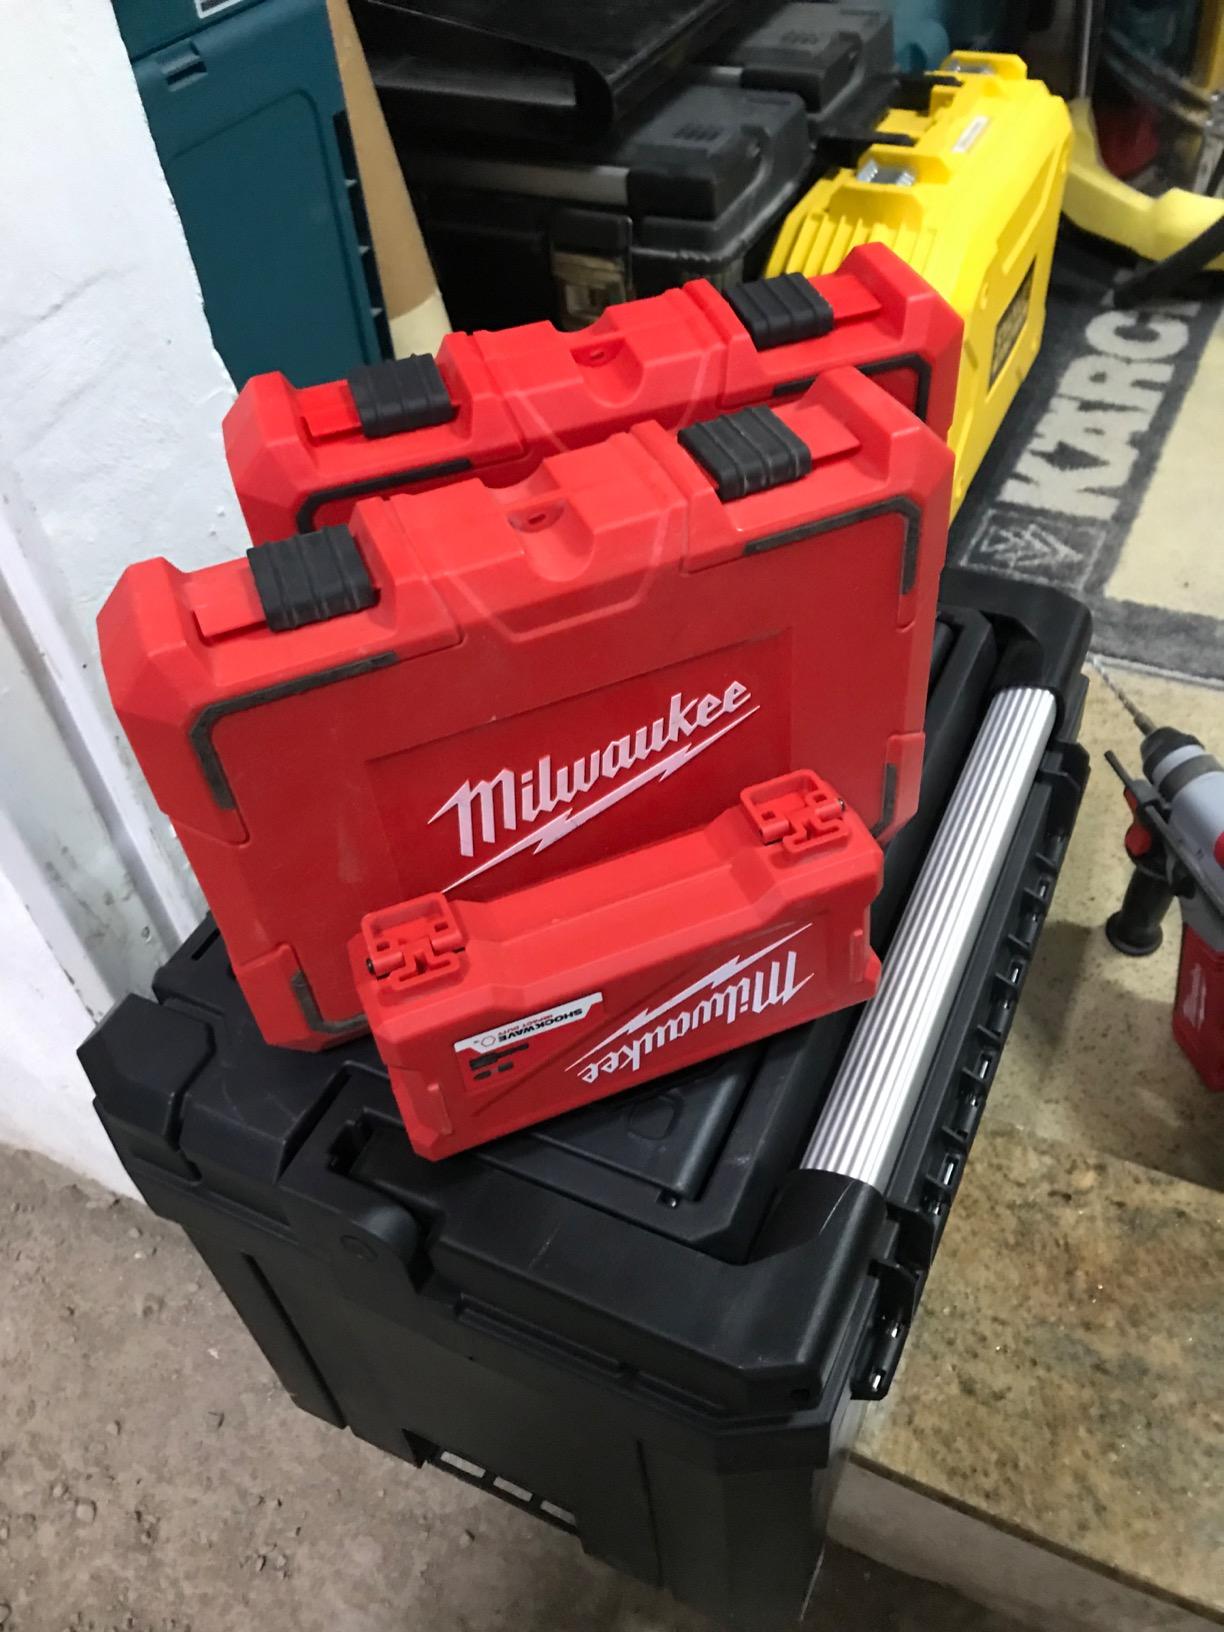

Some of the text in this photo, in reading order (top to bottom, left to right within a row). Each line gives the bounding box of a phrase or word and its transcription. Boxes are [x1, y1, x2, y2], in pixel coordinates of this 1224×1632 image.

[428, 681, 751, 857] Milwaukee
[498, 1008, 583, 1042] SHOCKWAVE
[522, 1014, 553, 1029] IMPACT
[577, 951, 814, 1083] Milwaukee
